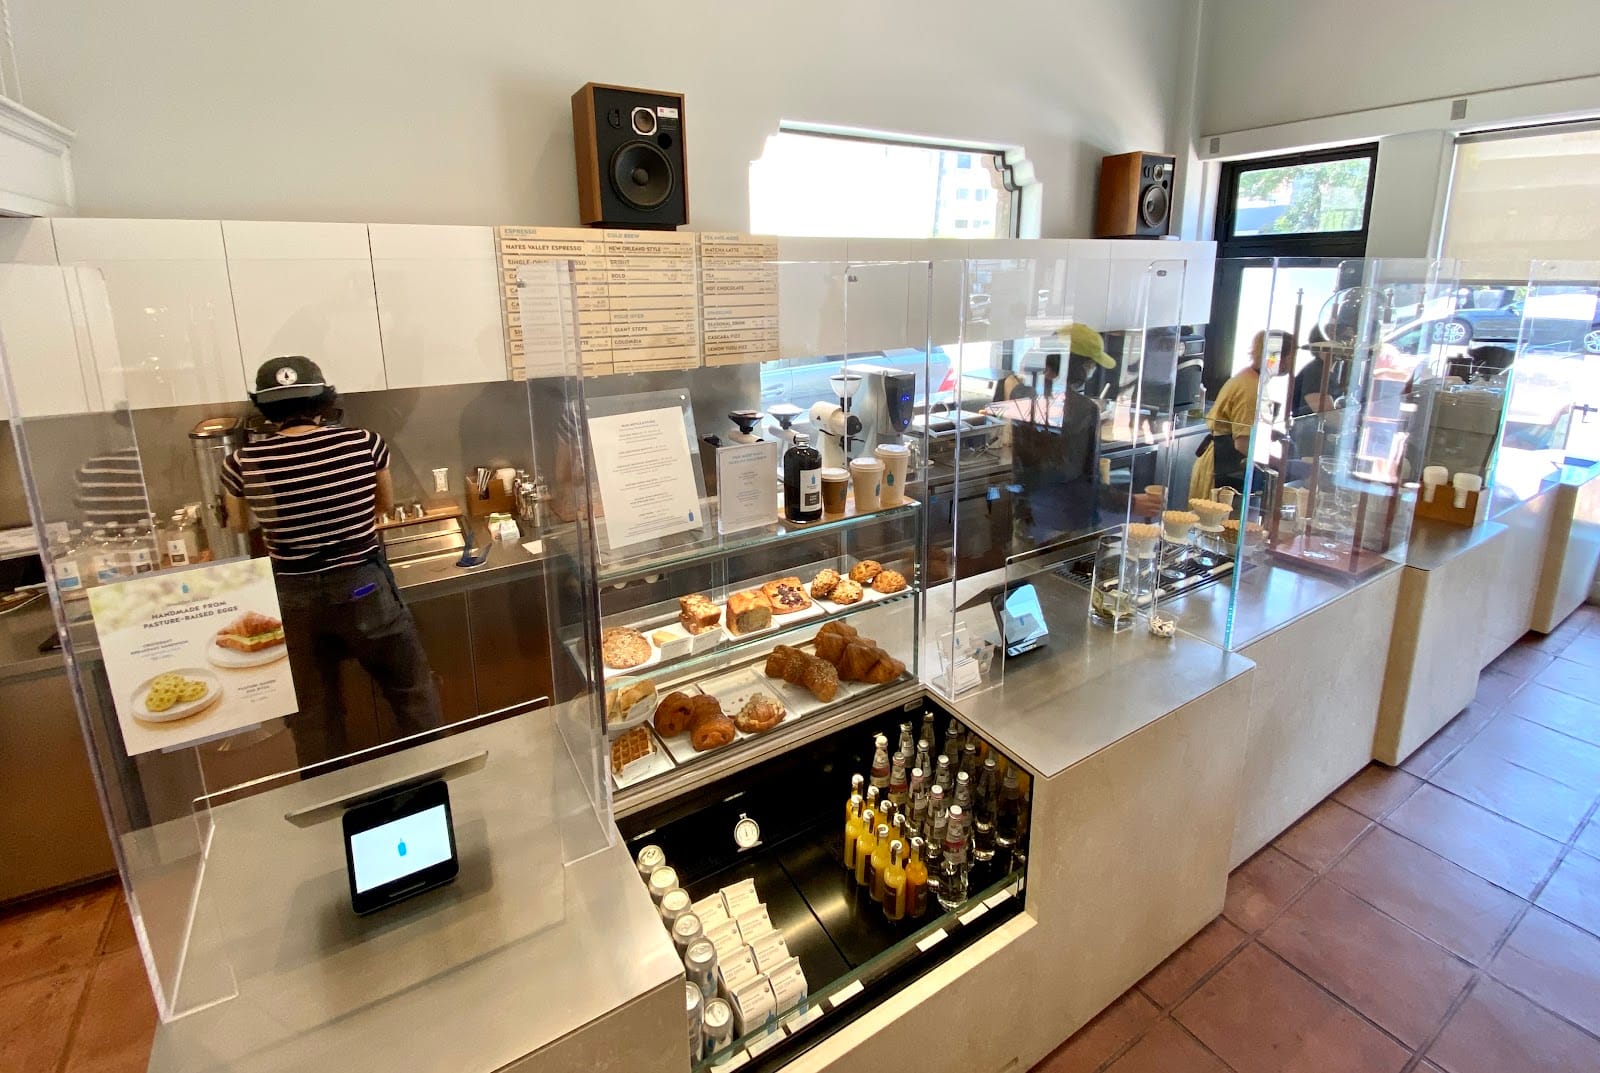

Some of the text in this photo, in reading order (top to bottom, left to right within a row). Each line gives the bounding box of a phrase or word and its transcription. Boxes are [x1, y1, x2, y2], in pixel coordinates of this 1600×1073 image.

[143, 605, 238, 629] PASTURE-RAISED EGGS
[151, 605, 200, 619] HANDMADE
[202, 600, 227, 610] FROM
